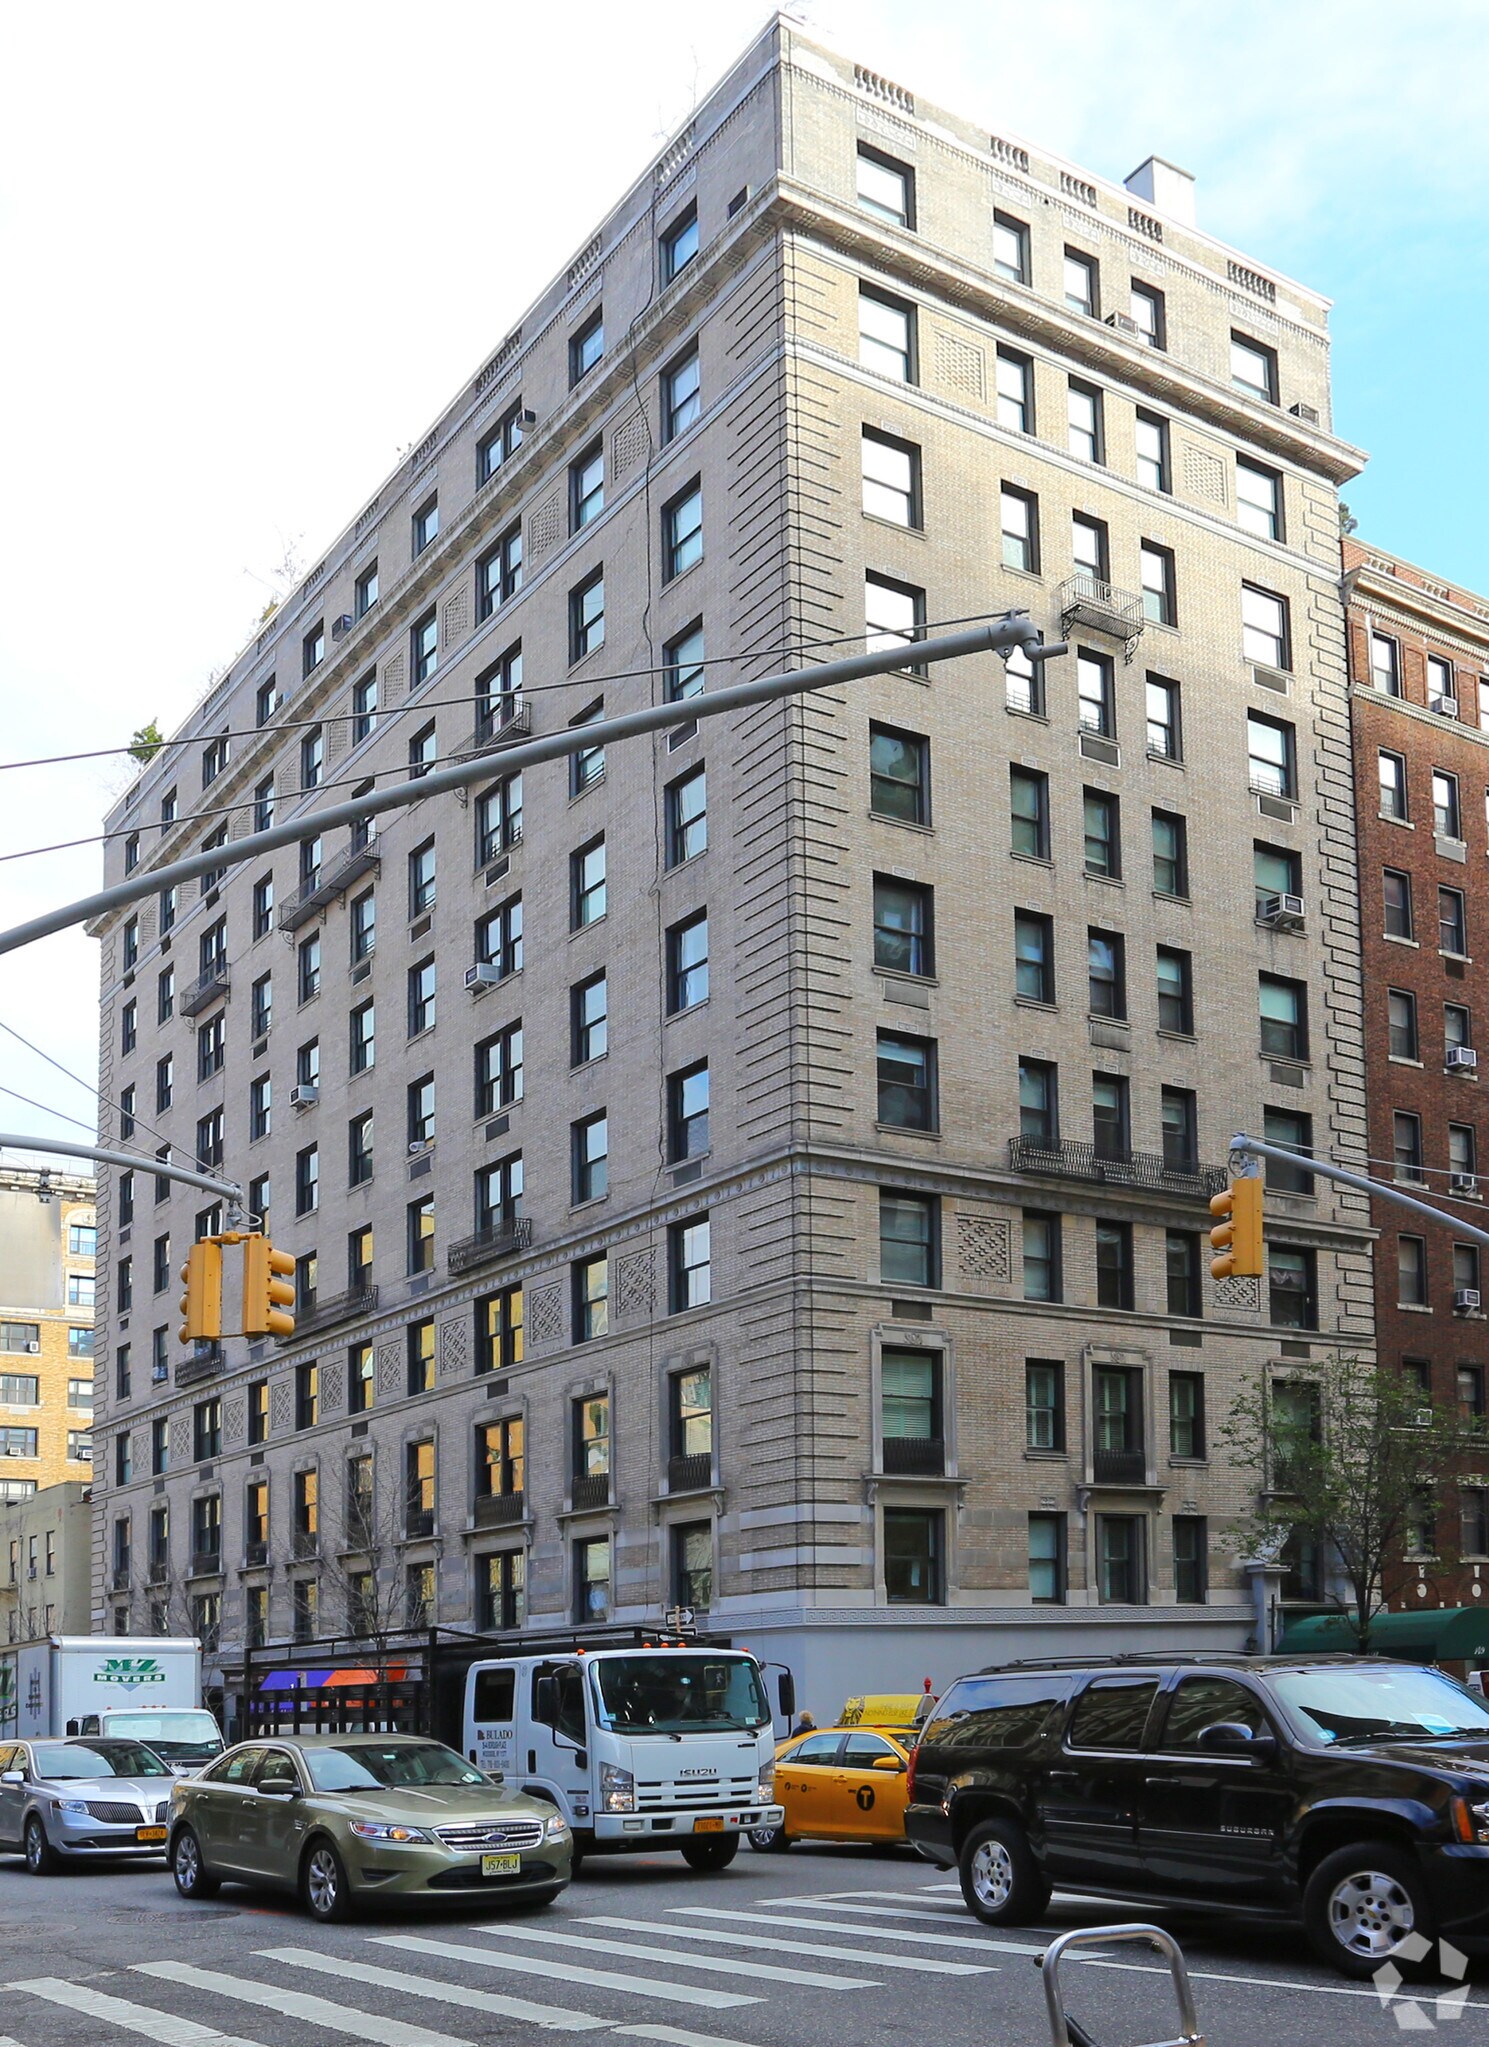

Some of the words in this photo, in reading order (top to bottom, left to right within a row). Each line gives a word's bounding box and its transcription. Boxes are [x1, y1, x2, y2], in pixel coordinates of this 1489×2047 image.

[104, 1658, 158, 1672] MZ
[95, 1674, 163, 1682] MOVERS
[486, 1730, 513, 1740] BULADO
[680, 1768, 717, 1777] ISUZU
[1220, 1825, 1275, 1836] SUBURBAN
